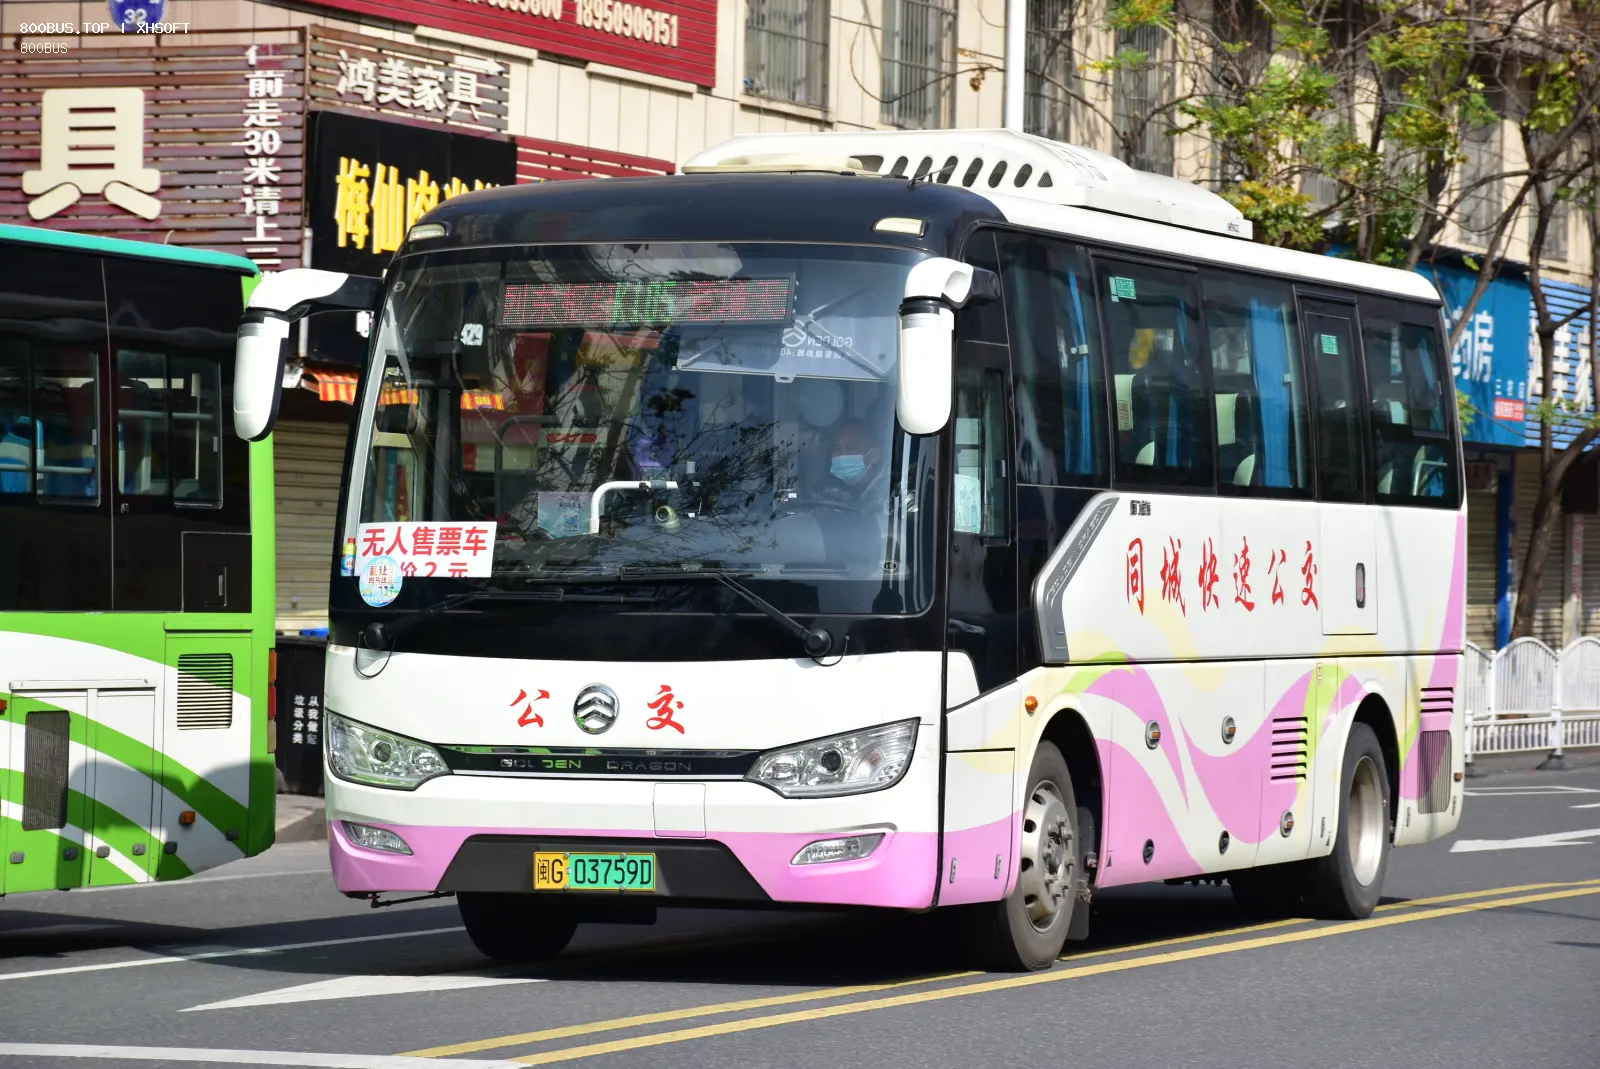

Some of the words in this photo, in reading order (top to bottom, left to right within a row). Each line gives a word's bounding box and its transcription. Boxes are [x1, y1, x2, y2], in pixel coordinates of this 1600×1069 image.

[124, 8, 147, 24] 32
[336, 49, 482, 121] 鸿美家具
[22, 87, 162, 220] 具
[362, 526, 488, 557] 无人售票车
[1126, 535, 1318, 618] 同城快速公交
[606, 760, 692, 771] DRAGON
